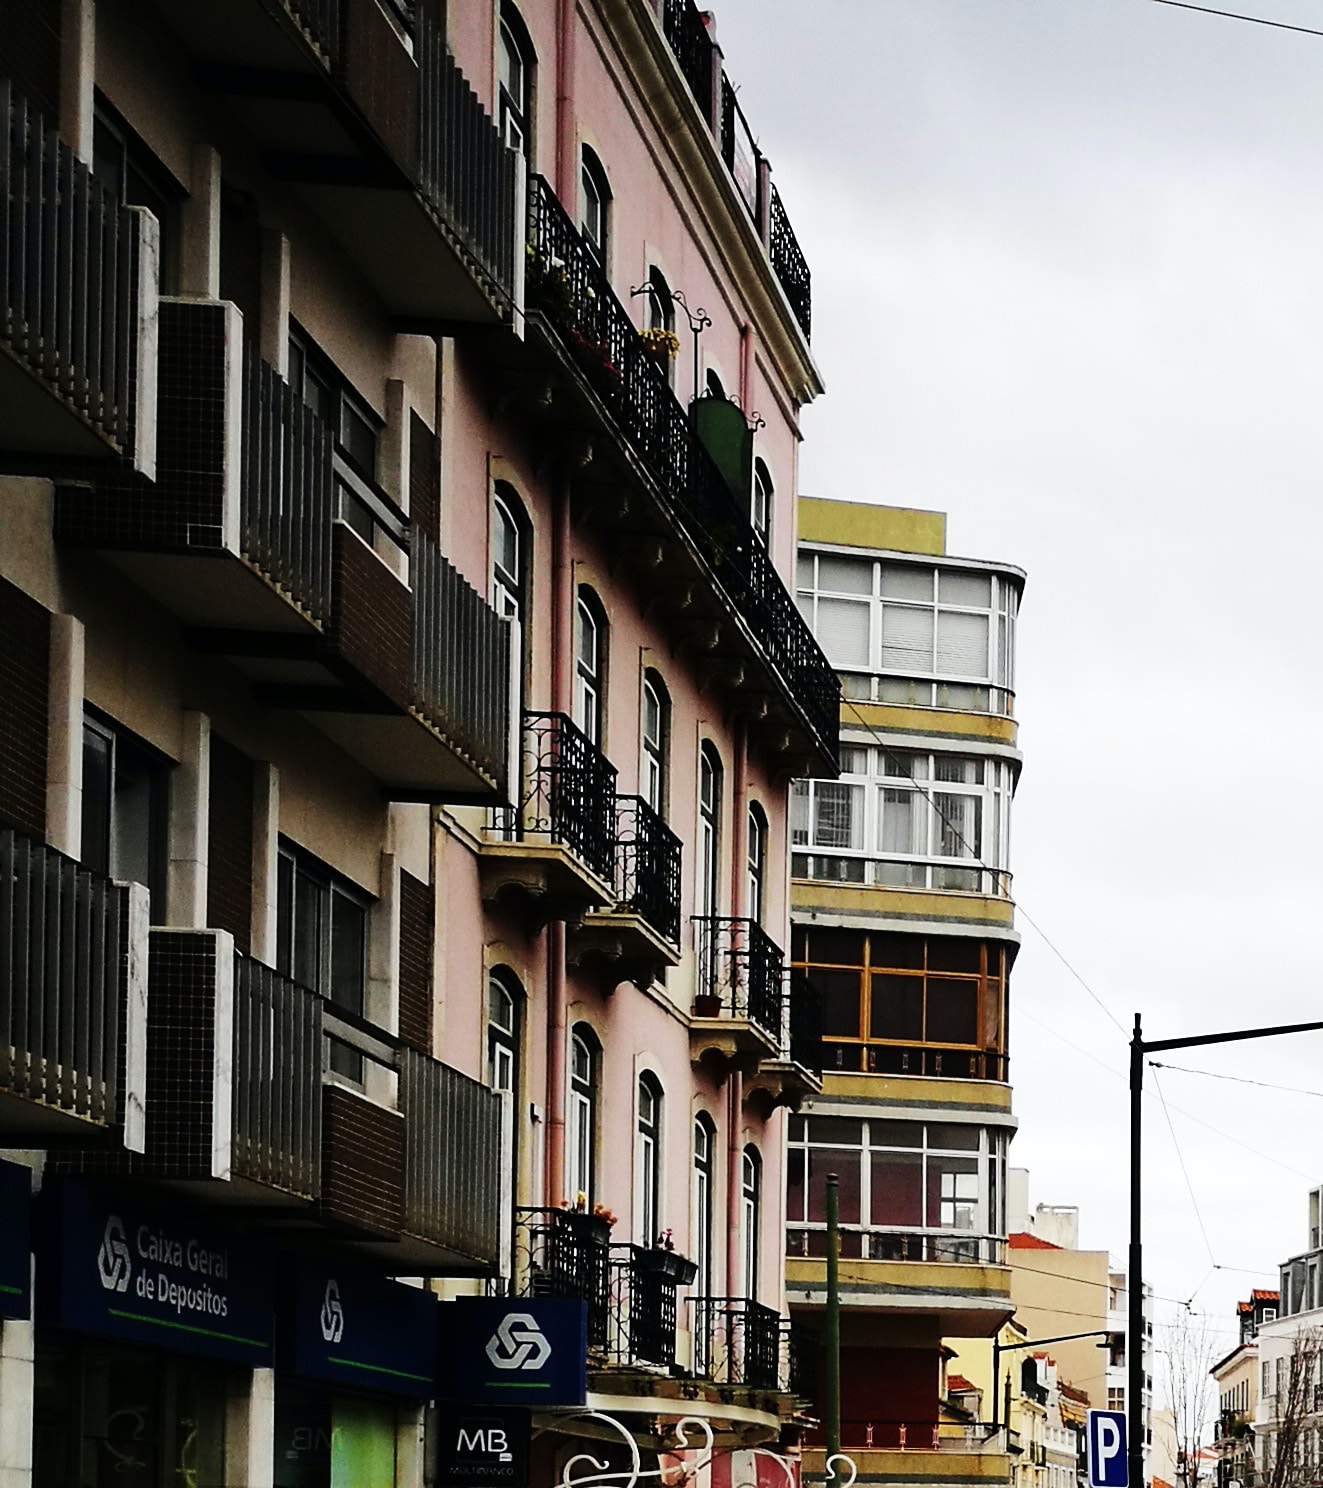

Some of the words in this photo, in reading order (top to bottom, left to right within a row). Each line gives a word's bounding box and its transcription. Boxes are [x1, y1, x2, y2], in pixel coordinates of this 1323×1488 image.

[137, 1224, 183, 1268] Caixa
[187, 1238, 229, 1280] Geral
[136, 1268, 155, 1301] de
[158, 1273, 228, 1318] Depositos
[457, 1429, 508, 1452] MB
[1096, 1416, 1120, 1482] P
